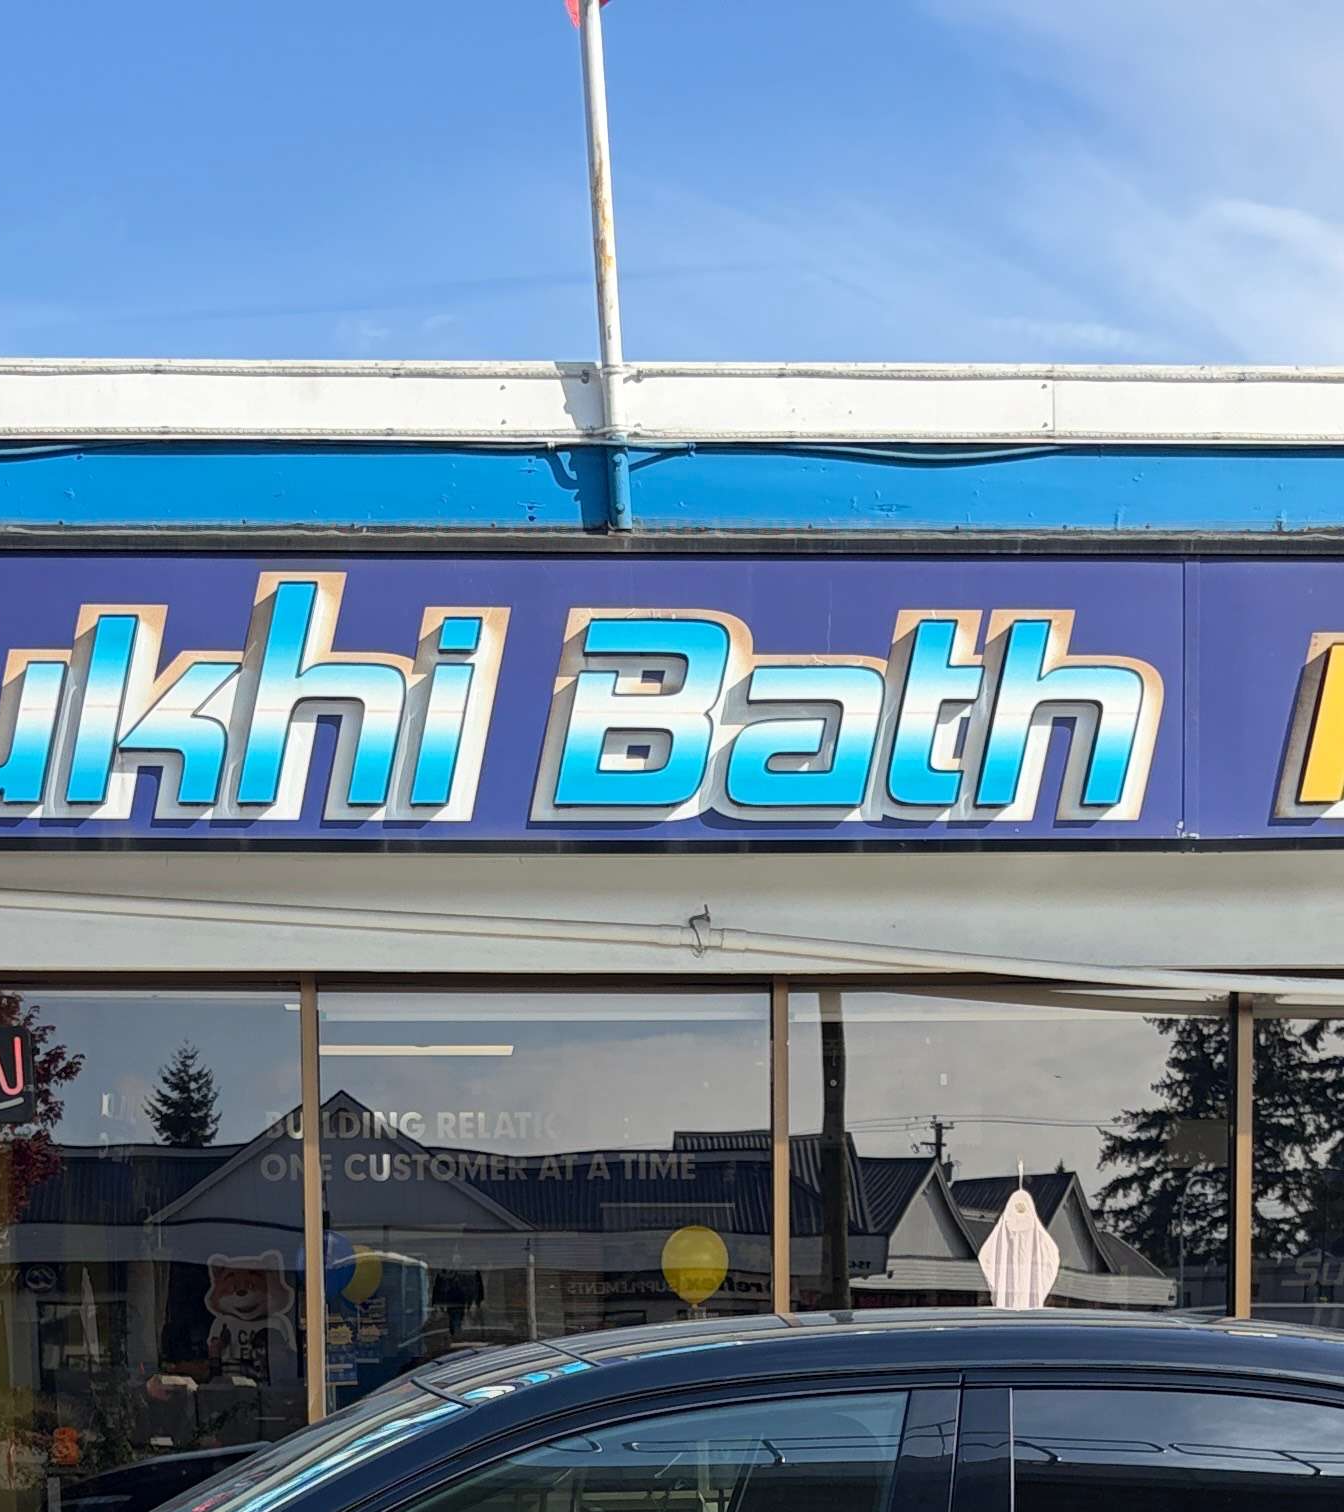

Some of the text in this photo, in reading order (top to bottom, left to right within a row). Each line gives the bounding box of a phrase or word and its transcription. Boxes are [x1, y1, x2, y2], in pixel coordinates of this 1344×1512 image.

[529, 606, 1163, 823] Bath
[264, 1111, 425, 1140] BULDING
[344, 1153, 527, 1182] CUSTOMER
[539, 1153, 579, 1181] AT
[586, 1153, 611, 1181] A
[619, 1153, 696, 1182] TIME
